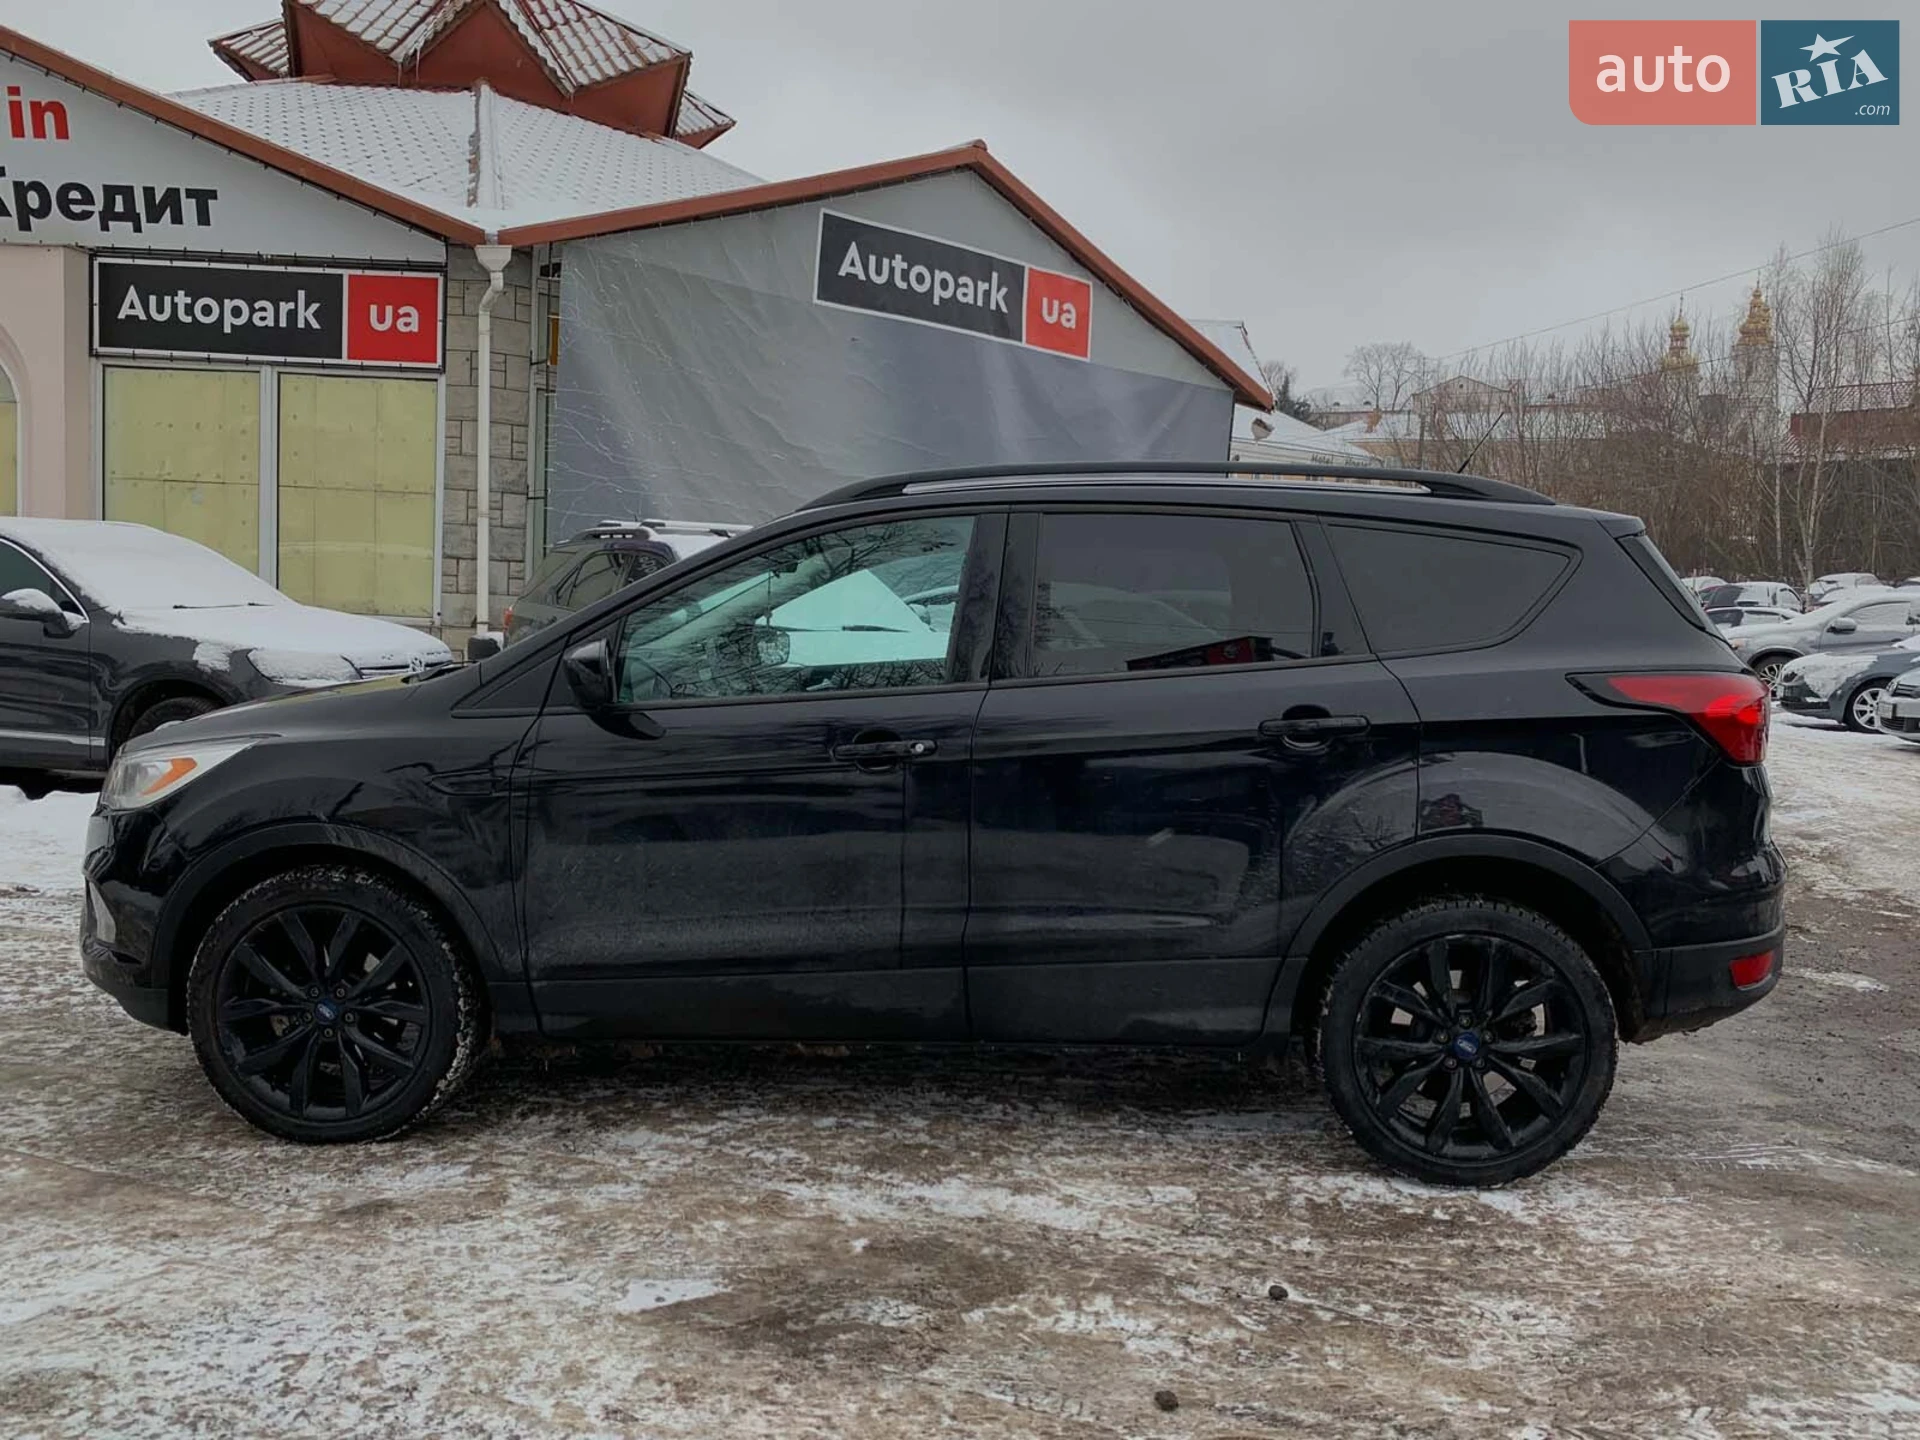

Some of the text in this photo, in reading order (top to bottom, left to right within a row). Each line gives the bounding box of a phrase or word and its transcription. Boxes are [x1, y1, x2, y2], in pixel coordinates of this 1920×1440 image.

[7, 86, 70, 140] in
[117, 285, 419, 333] Autopark ua
[838, 241, 1076, 330] Autopark ua
